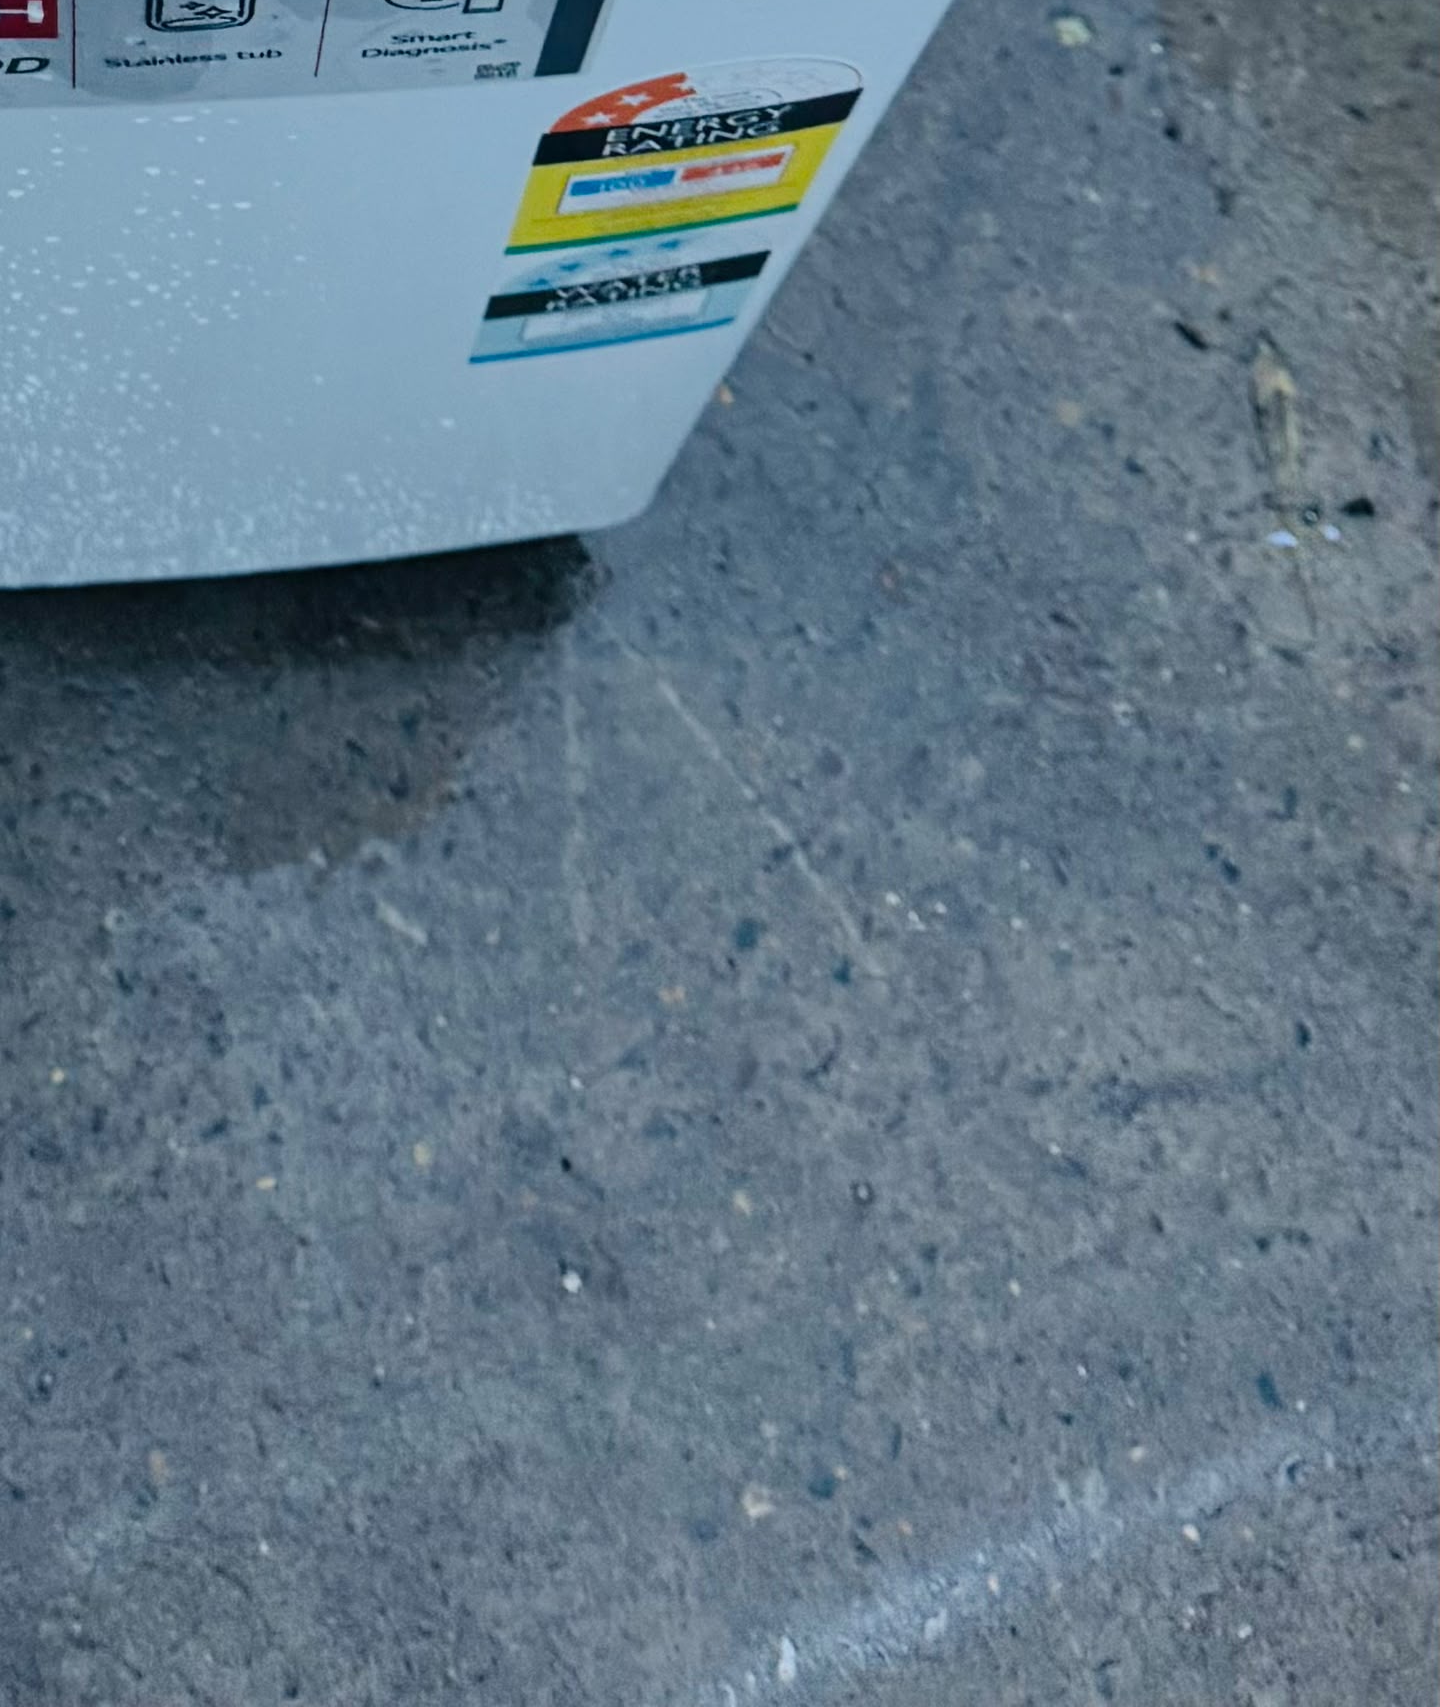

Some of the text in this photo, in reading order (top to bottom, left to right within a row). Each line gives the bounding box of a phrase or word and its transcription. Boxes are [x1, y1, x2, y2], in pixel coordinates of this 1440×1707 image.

[391, 31, 475, 44] Smart
[104, 48, 282, 68] Stainless tub
[602, 120, 781, 156] RATING
[607, 106, 792, 142] ENERGY
